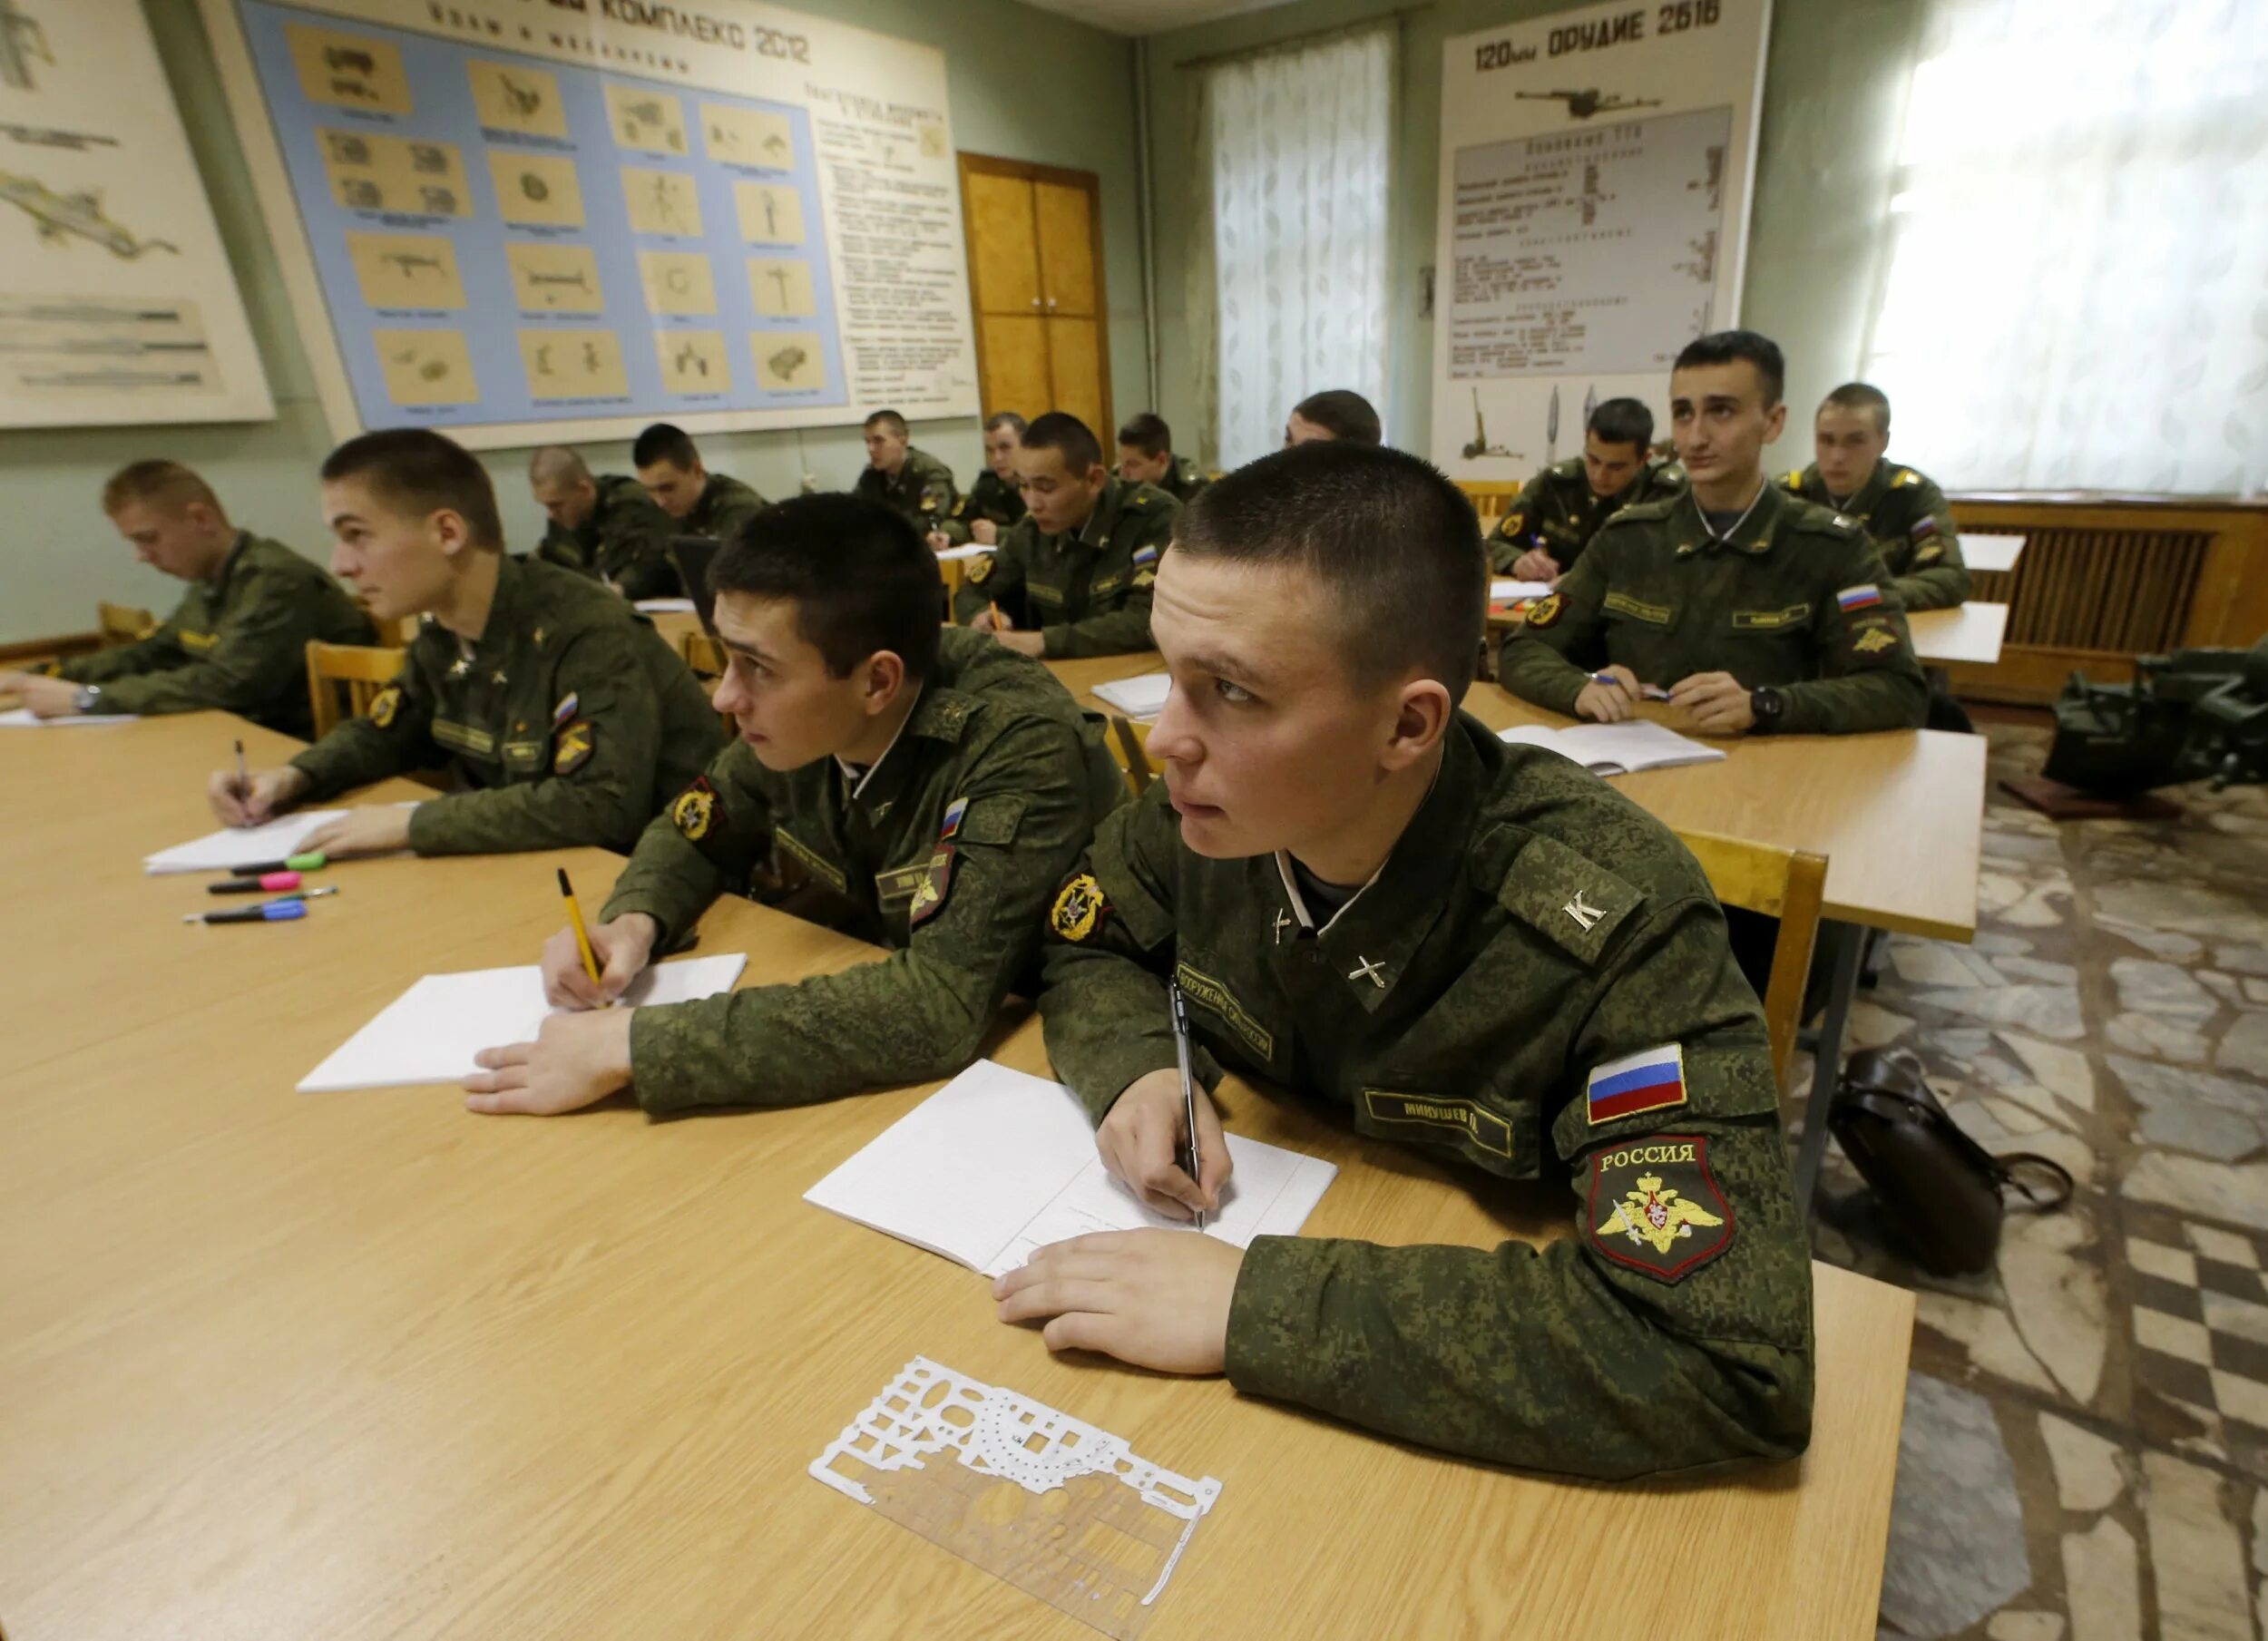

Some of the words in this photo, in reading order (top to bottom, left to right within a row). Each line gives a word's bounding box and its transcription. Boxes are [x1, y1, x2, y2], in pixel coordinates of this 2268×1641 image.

[1548, 11, 1647, 58] ОРУДИЕ
[1562, 890, 1607, 933] К
[1600, 1145, 1696, 1171] РОССИЯ
